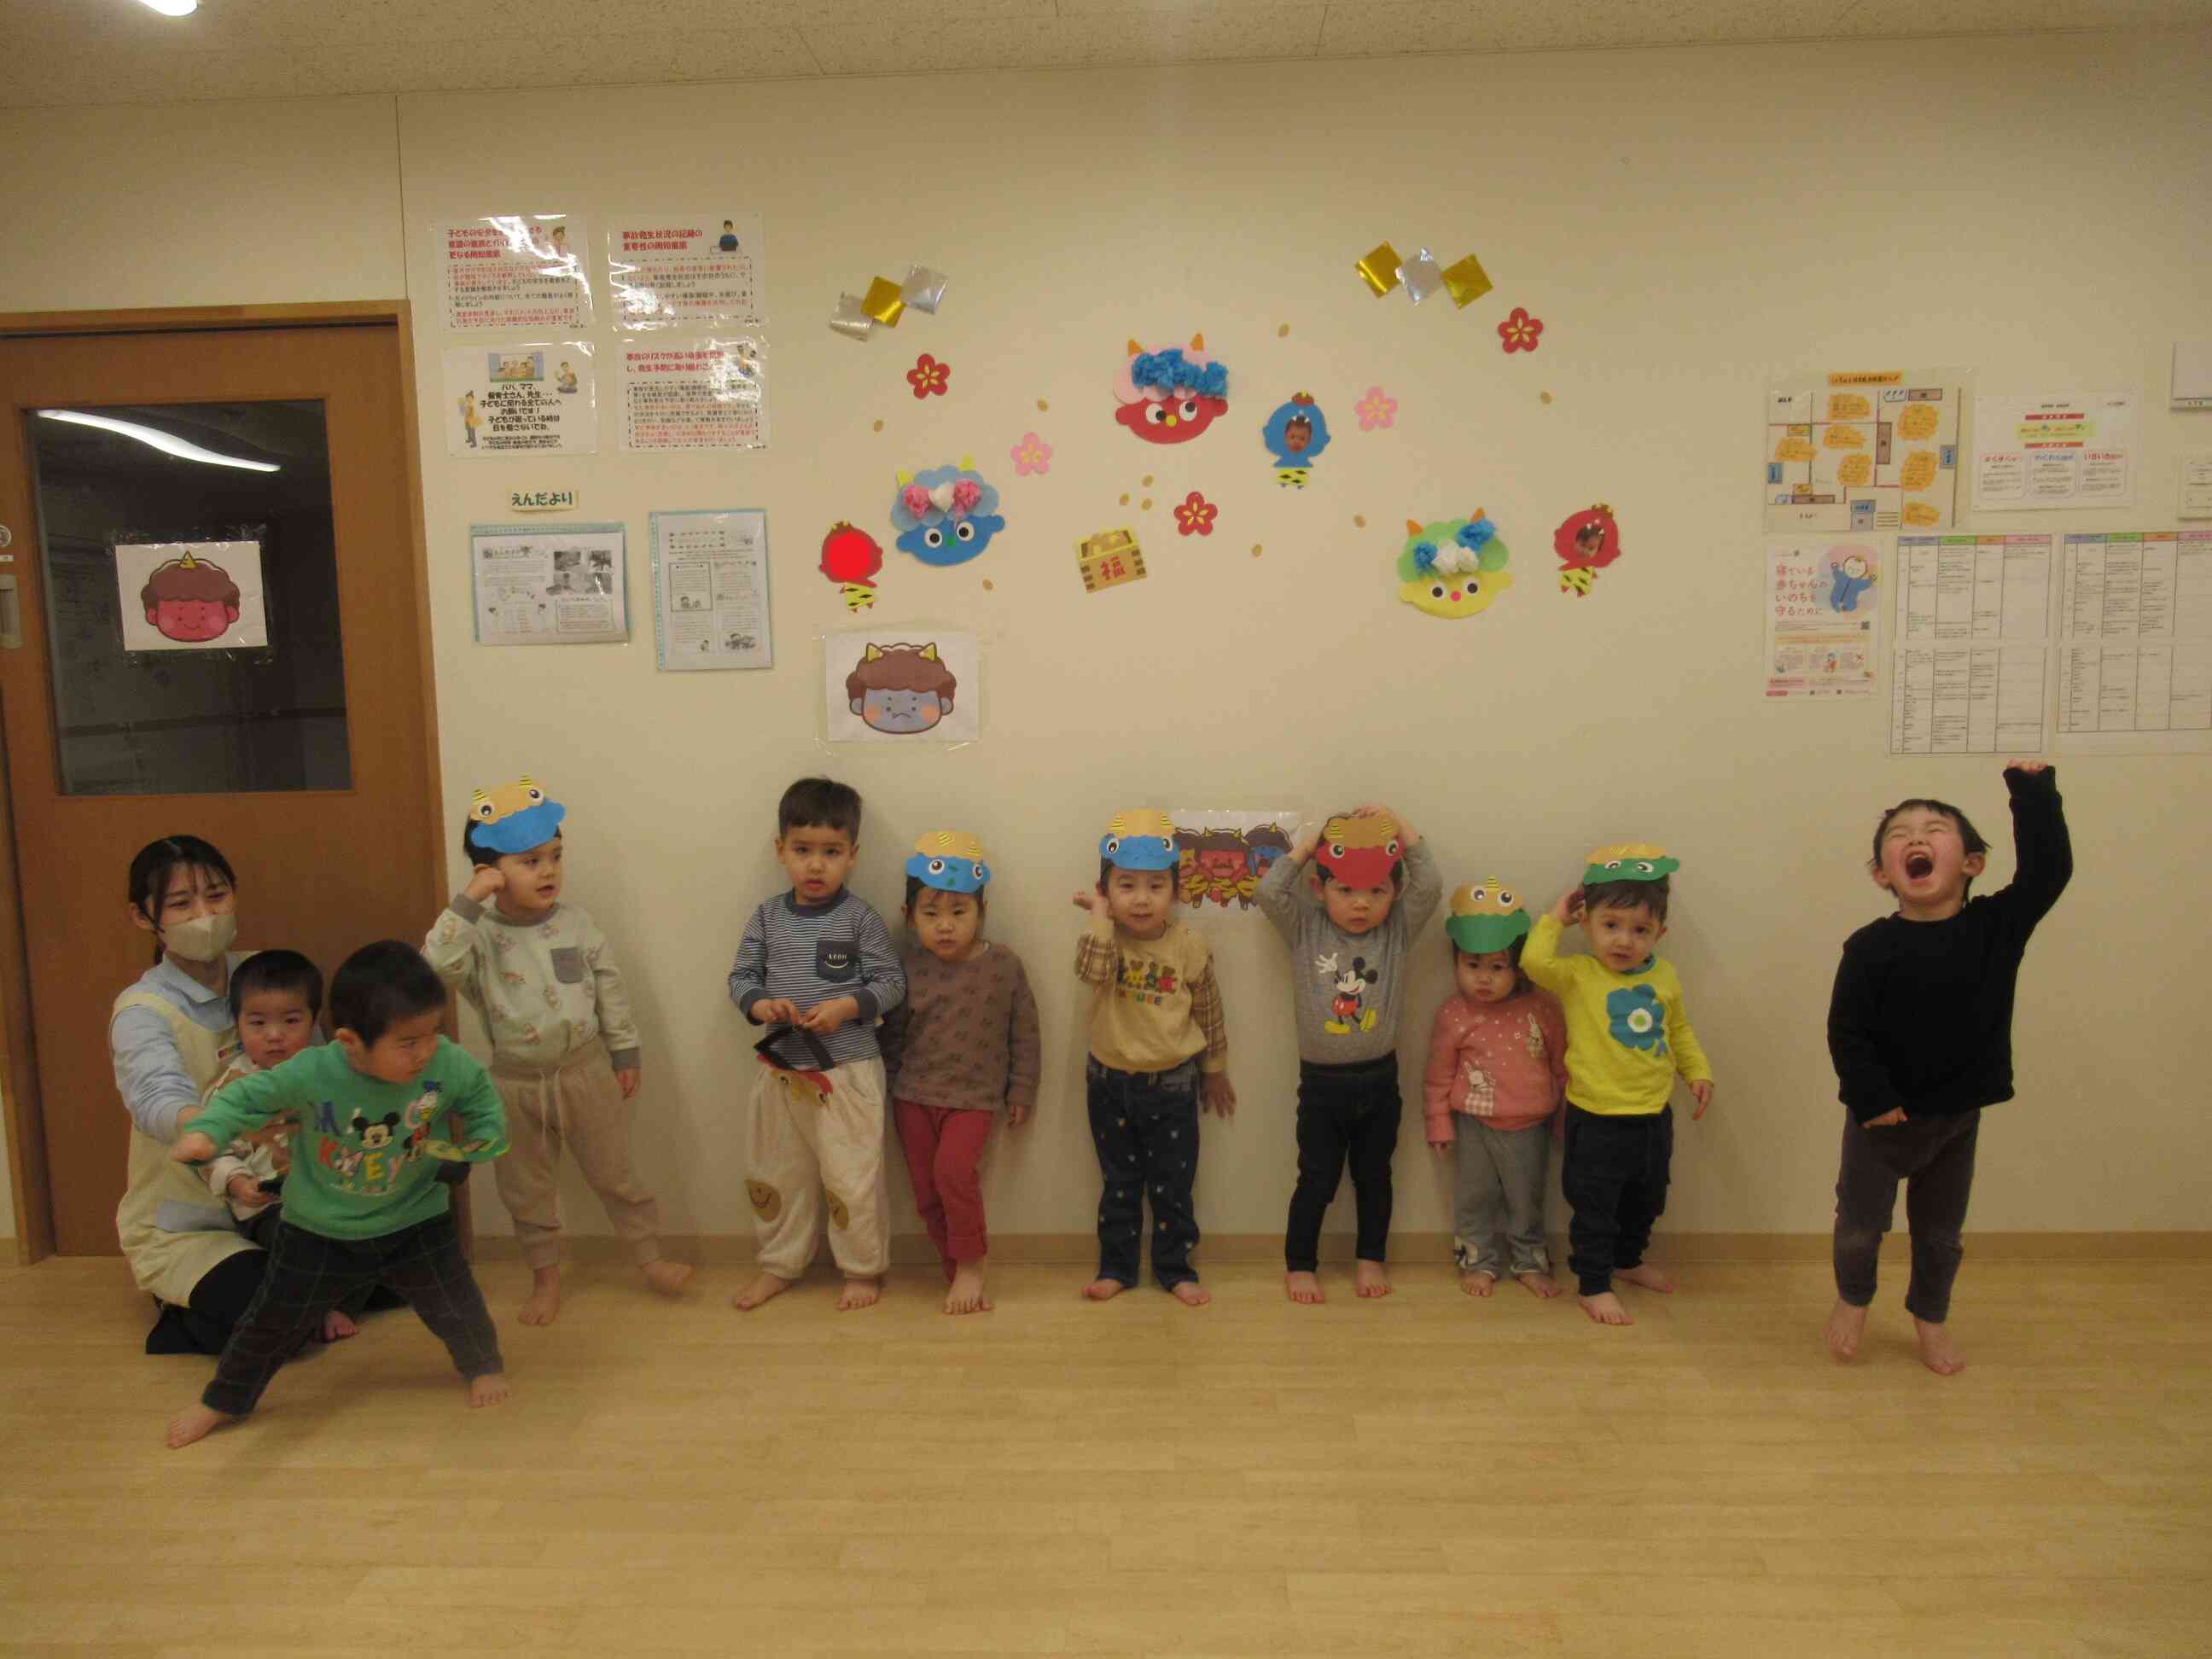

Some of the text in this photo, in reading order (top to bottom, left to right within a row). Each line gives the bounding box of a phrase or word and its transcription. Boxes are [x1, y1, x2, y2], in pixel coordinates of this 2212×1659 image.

[512, 492, 573, 505] えんだより
[1100, 556, 1126, 580] 福
[1776, 579, 1829, 591] 赤ちゃんの
[1776, 591, 1816, 603] いのちを
[1775, 604, 1823, 616] 守るために
